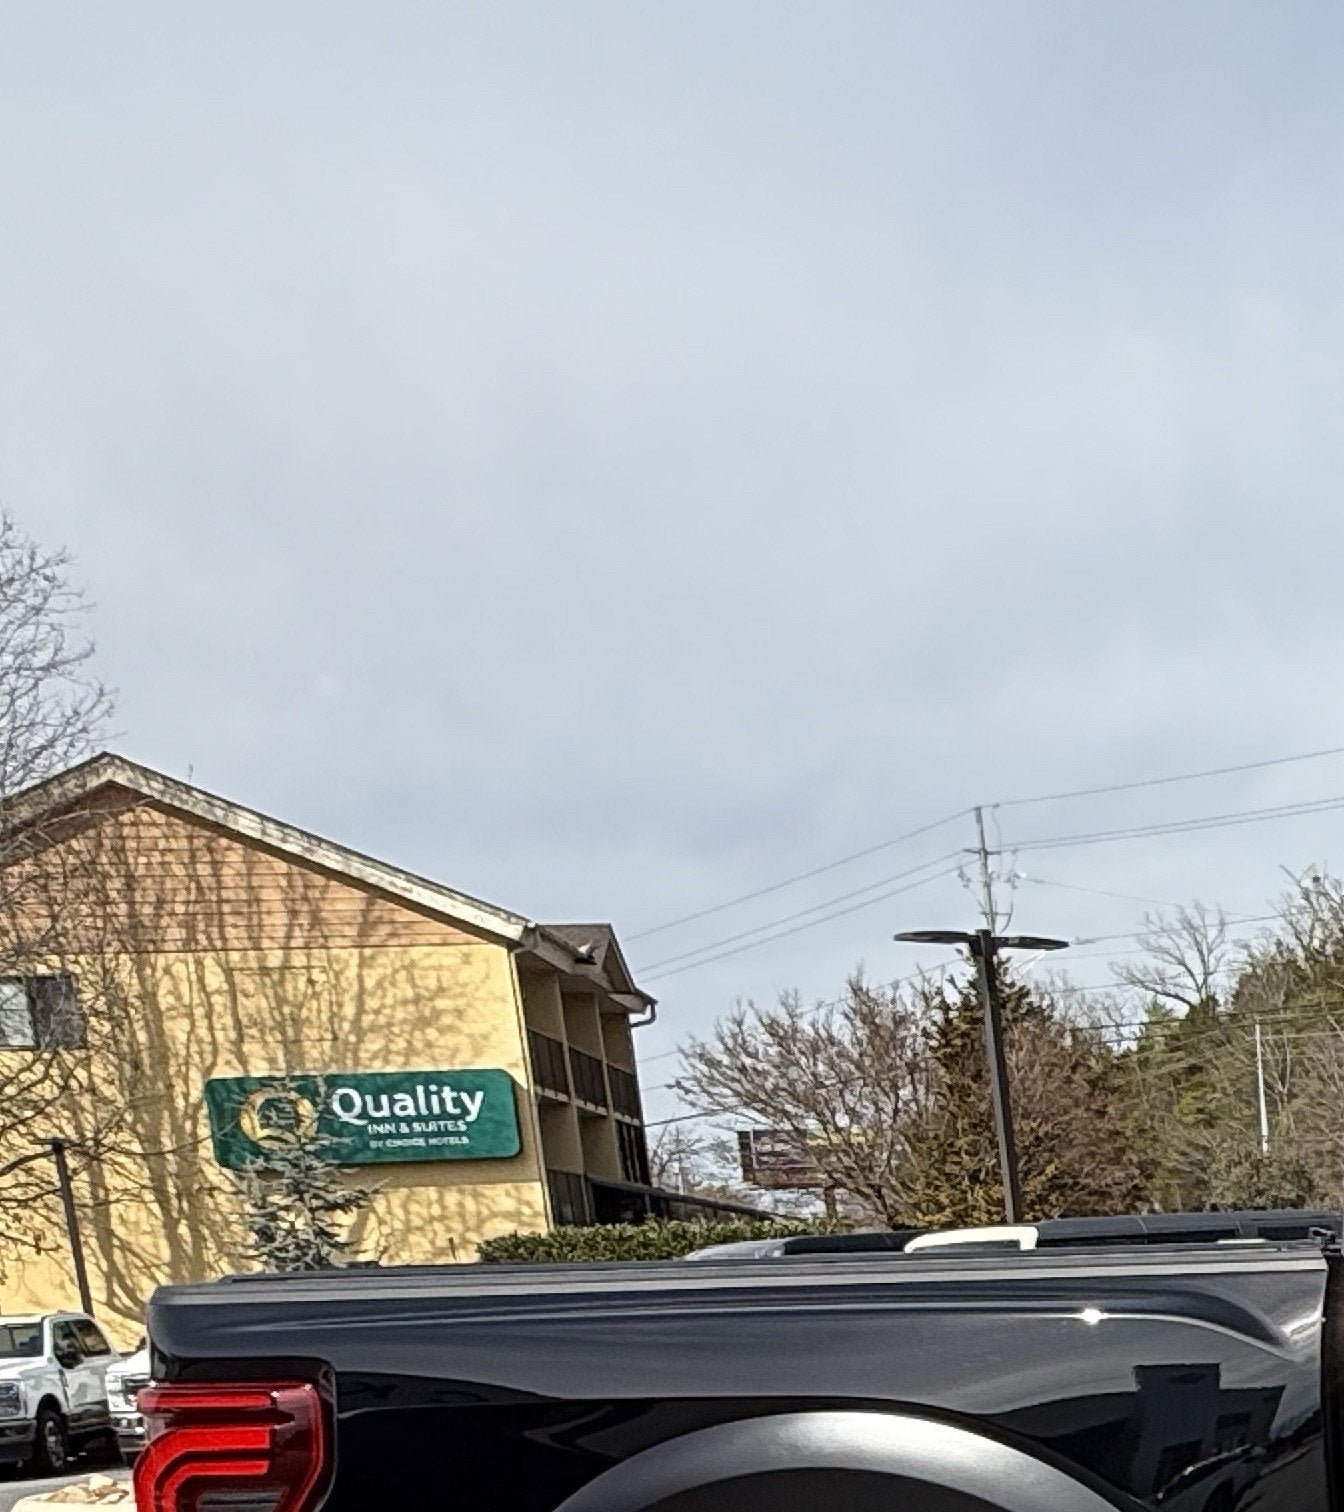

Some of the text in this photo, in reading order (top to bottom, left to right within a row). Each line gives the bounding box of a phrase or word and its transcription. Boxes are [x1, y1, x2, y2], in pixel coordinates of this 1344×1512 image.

[331, 1084, 485, 1125] Quality
[367, 1119, 468, 1136] INN & SUITES
